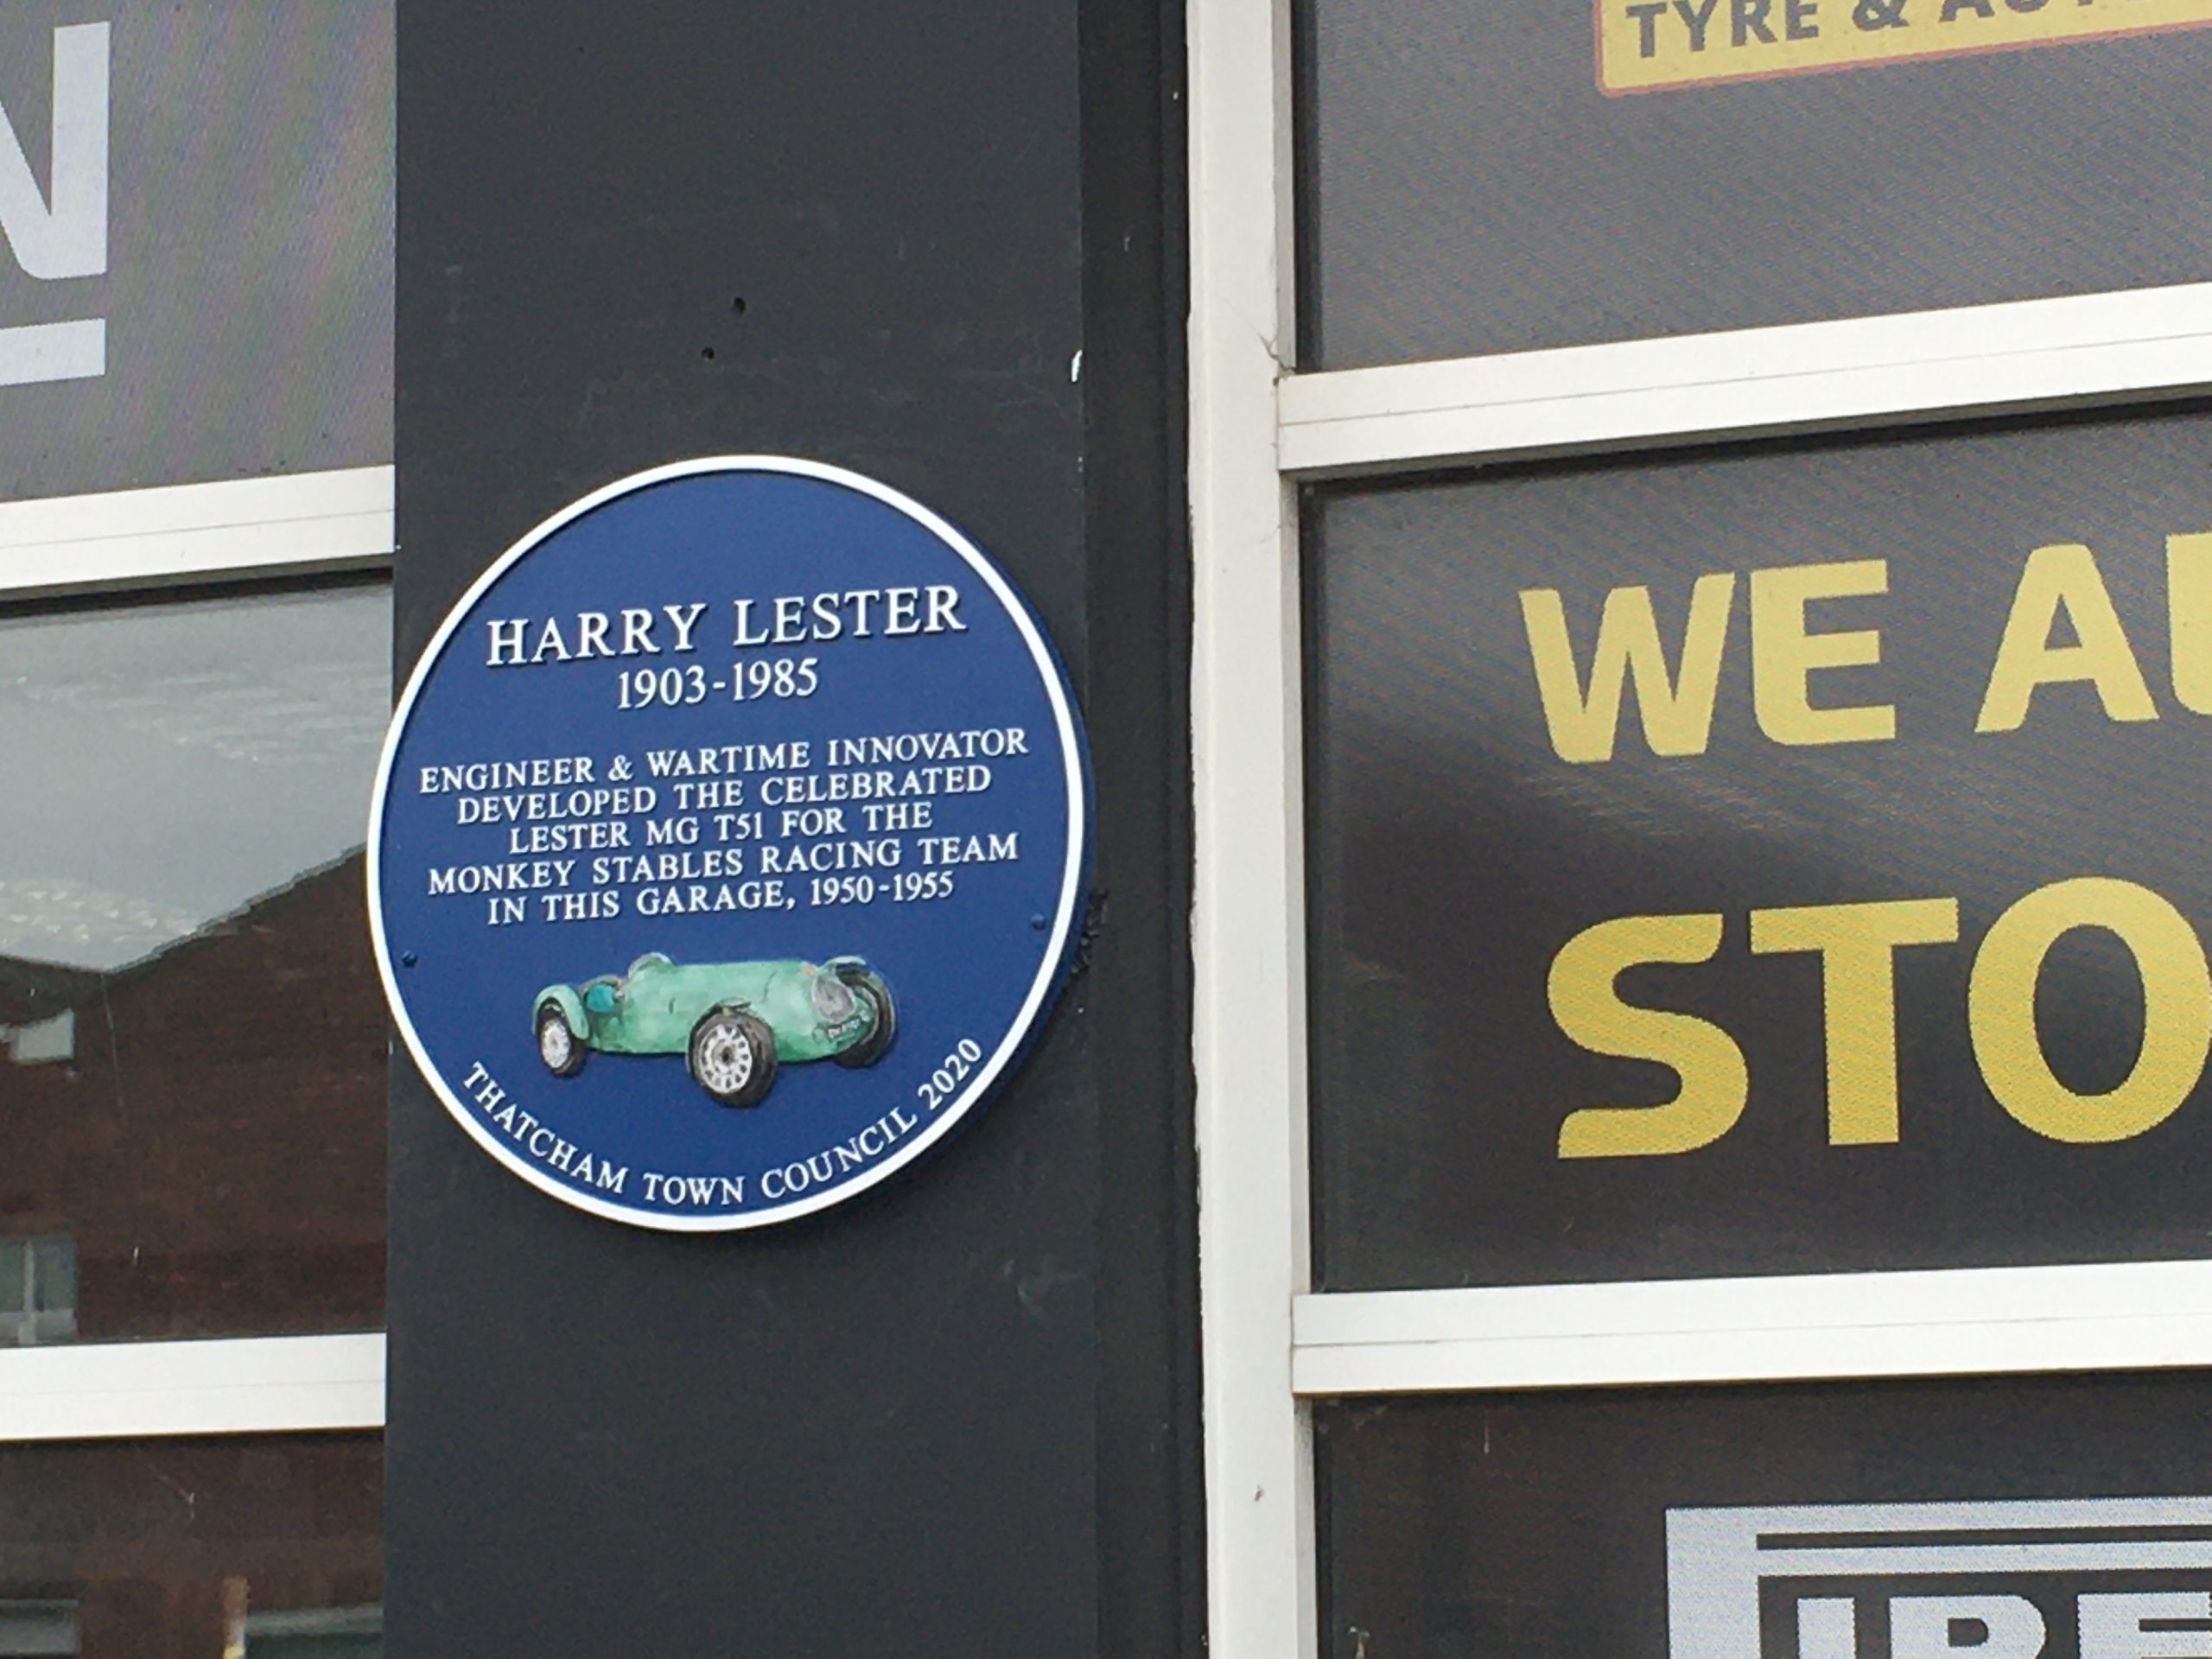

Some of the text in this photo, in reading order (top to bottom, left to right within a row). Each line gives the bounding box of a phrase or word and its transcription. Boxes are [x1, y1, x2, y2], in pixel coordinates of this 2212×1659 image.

[1624, 0, 1819, 58] TYRE
[486, 587, 968, 667] HARRY LESTER
[618, 658, 818, 710] 1903-1985
[1518, 558, 1896, 764] WE
[419, 727, 1029, 794] ENGINEER & WARTIME INNOVATOR
[457, 764, 992, 825] DEVELOPED THE CELEBRATED
[509, 821, 631, 855] LESTER
[645, 817, 700, 847] MG
[780, 806, 848, 838] FOR
[861, 800, 933, 832] THE
[428, 832, 1019, 896] MONKEY STABLES RACING TEAM
[487, 869, 954, 925] IN THIS GARAGE, 1950-1955
[1547, 875, 2212, 1159] STO
[463, 1039, 982, 1206] THATCHAM TOWN COUNCIL 2020
